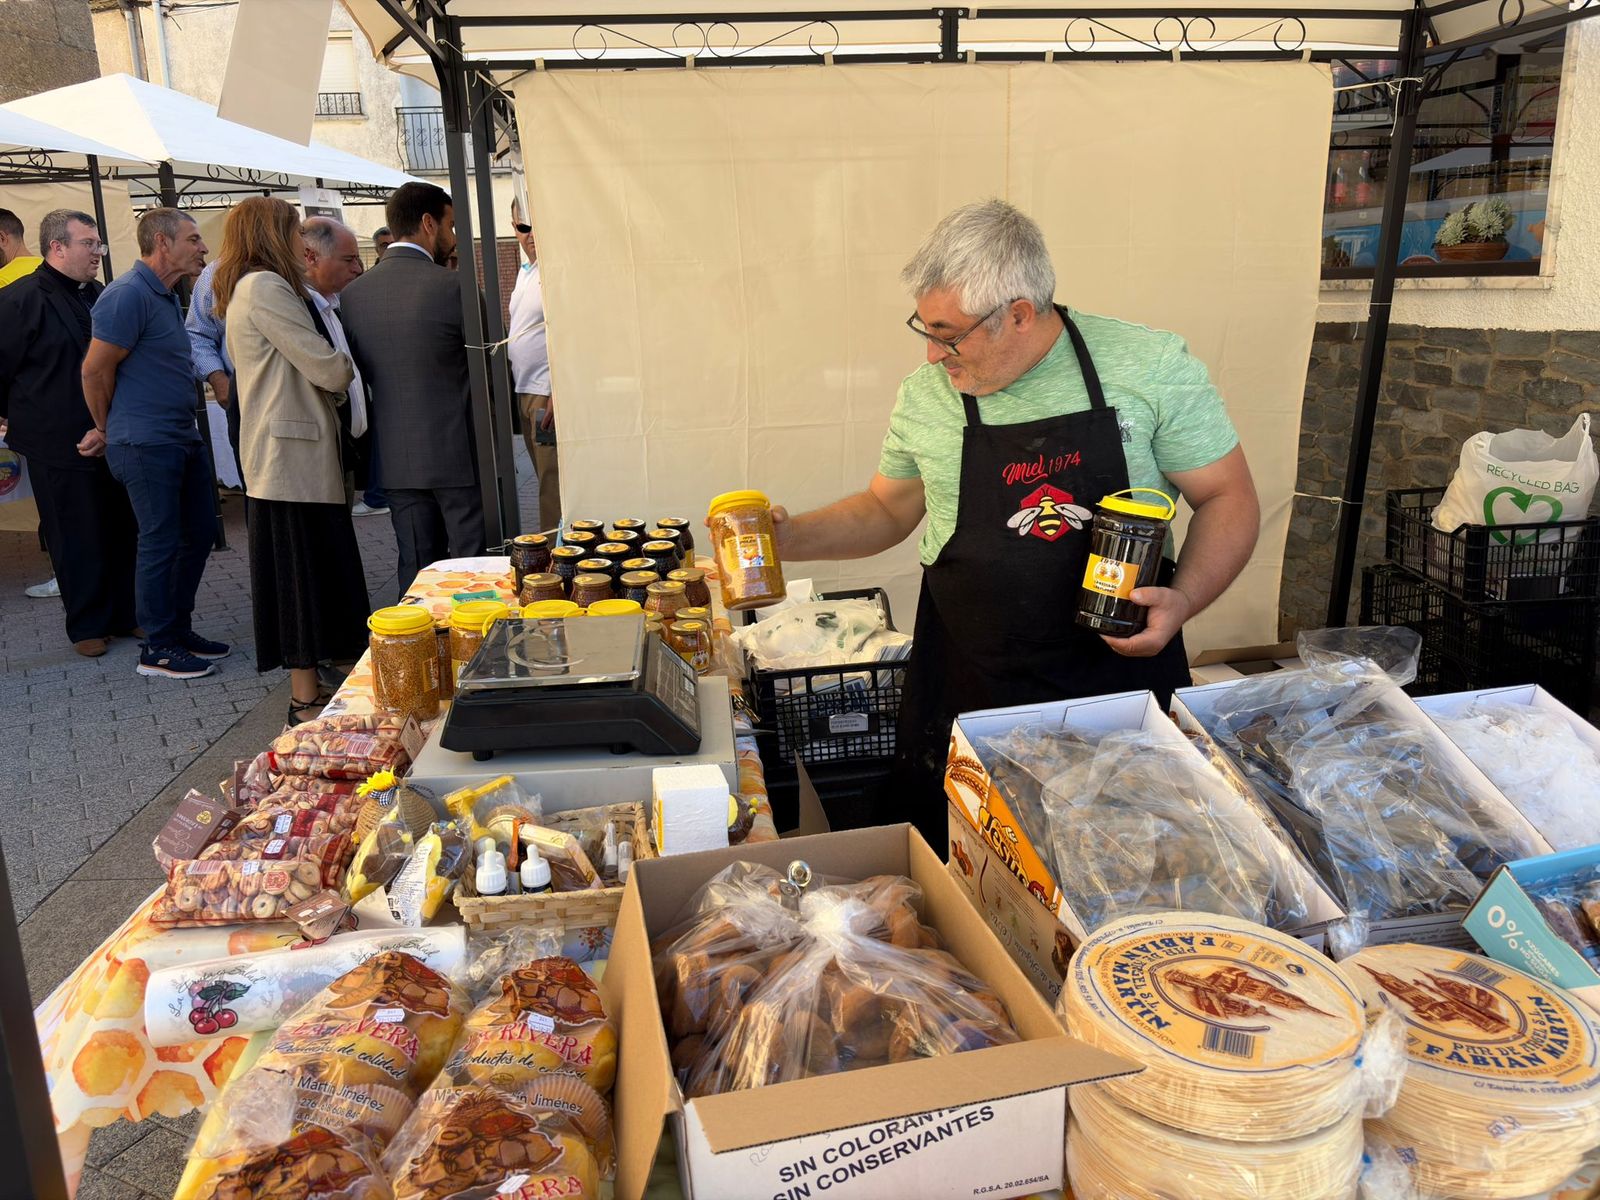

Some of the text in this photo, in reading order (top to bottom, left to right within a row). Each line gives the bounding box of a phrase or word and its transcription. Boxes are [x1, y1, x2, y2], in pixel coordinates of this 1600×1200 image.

[1002, 450, 1081, 485] Miel 1974
[1487, 464, 1580, 493] RECYCLED BAG
[1488, 905, 1524, 950] 0%
[1112, 936, 1217, 1029] FABIAN MARTIN
[500, 1022, 593, 1065] RIVERA
[1425, 1043, 1546, 1069] FABIAN
[1527, 995, 1570, 1060] MARTIN
[337, 1042, 355, 1056] de
[357, 1051, 408, 1081] calidad
[518, 1053, 535, 1069] de
[336, 1084, 384, 1112] Jiménez
[530, 1093, 583, 1114] Jiménez
[778, 1106, 961, 1183] SIN COLORAN
[816, 1104, 995, 1191] CONSERVANTES
